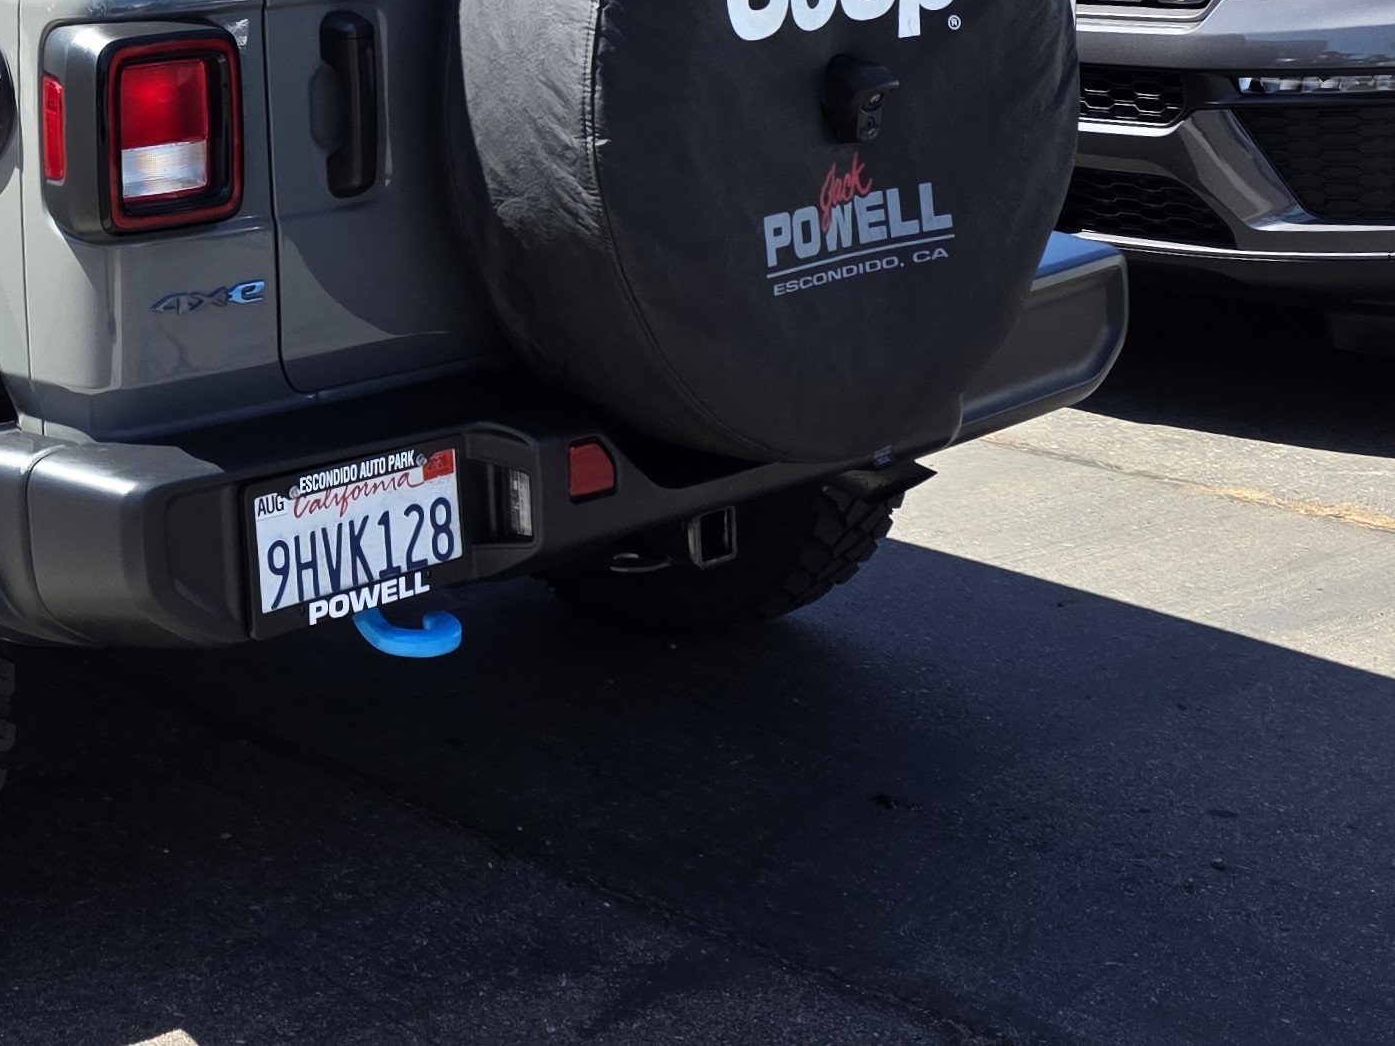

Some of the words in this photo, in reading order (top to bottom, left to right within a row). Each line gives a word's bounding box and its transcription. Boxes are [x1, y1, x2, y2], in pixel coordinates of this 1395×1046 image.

[819, 151, 873, 233] Jack
[763, 182, 954, 268] POWELL
[773, 256, 905, 297] ESCONDIDO,
[912, 247, 949, 264] CA
[293, 471, 425, 519] California
[299, 464, 357, 494] ESCONDIDO
[359, 457, 387, 479] AUTO
[388, 450, 415, 472] PARK
[257, 496, 285, 517] AUG
[266, 496, 455, 610] 9HVK128
[308, 571, 431, 626] POWELL
